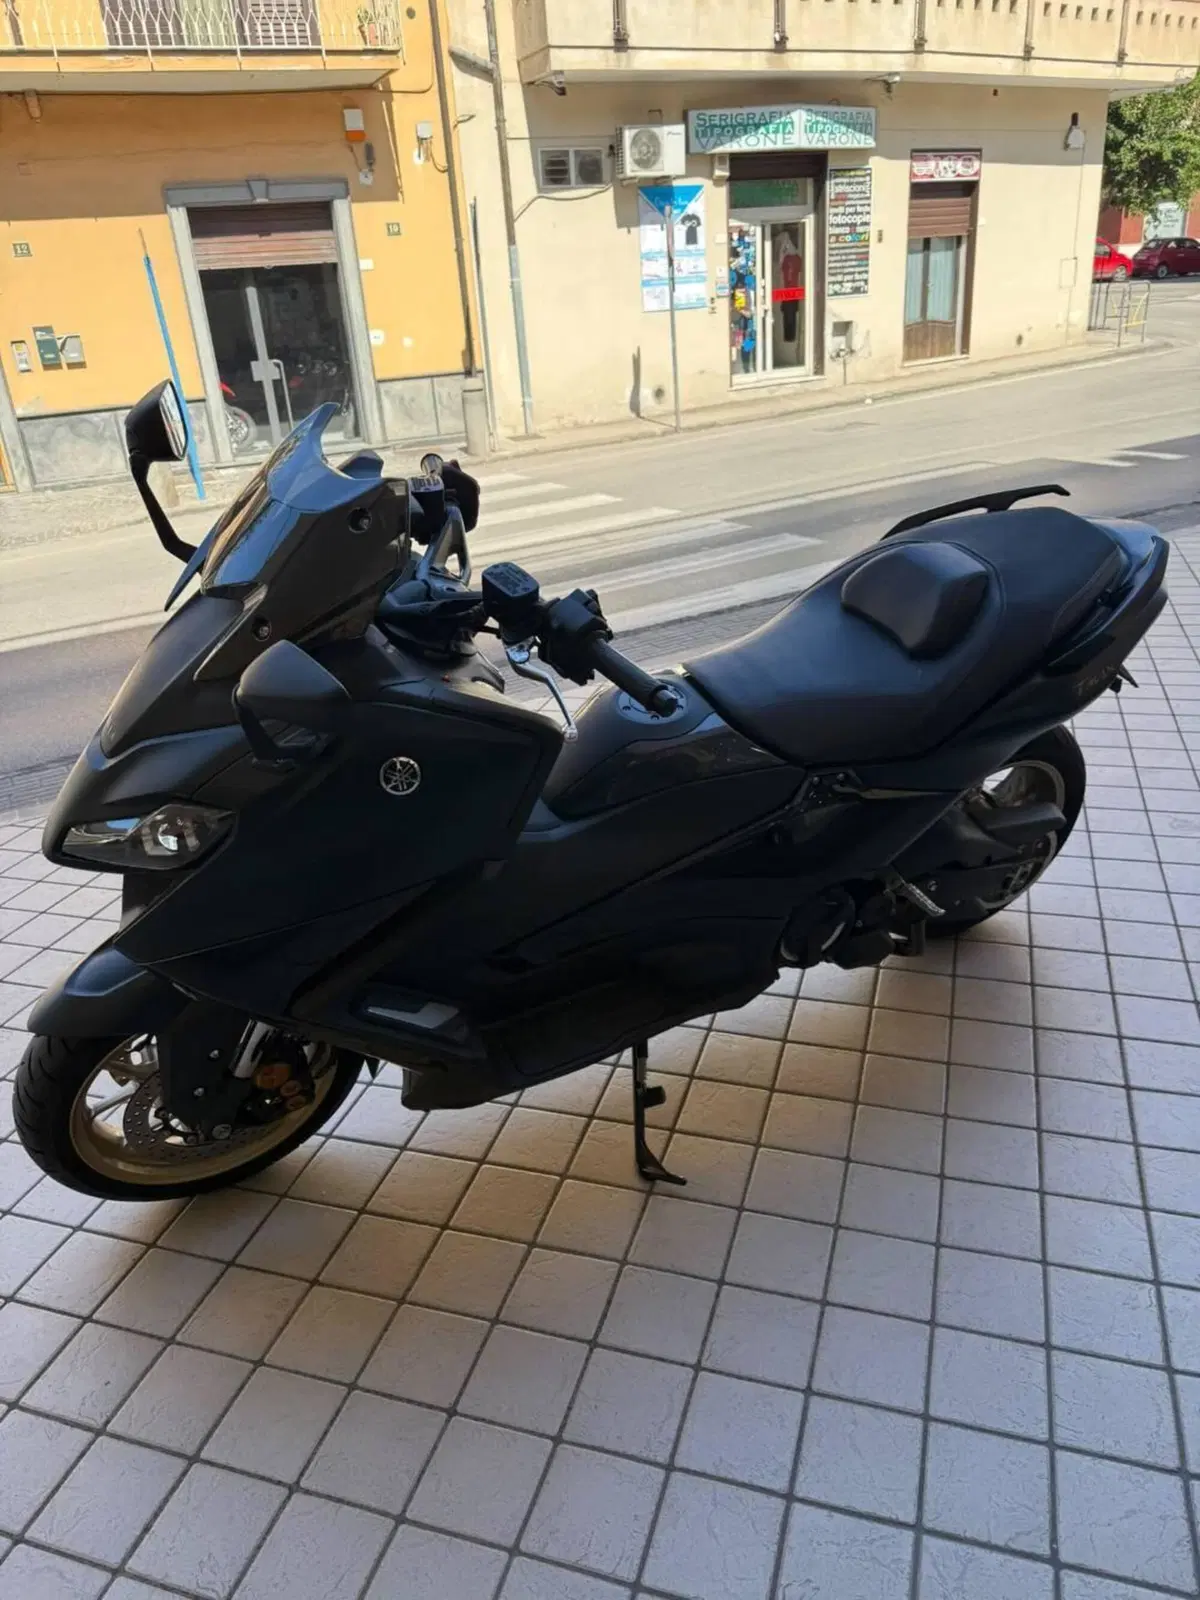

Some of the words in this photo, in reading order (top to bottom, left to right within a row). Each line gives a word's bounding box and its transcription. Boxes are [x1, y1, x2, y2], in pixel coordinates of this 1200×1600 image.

[696, 120, 794, 139] TIPOGRAFIA
[804, 120, 873, 137] TIPOGRAFIA
[697, 133, 795, 150] VARONE
[806, 133, 874, 147] VARONE
[829, 212, 871, 225] fotocopie
[15, 244, 28, 254] 12
